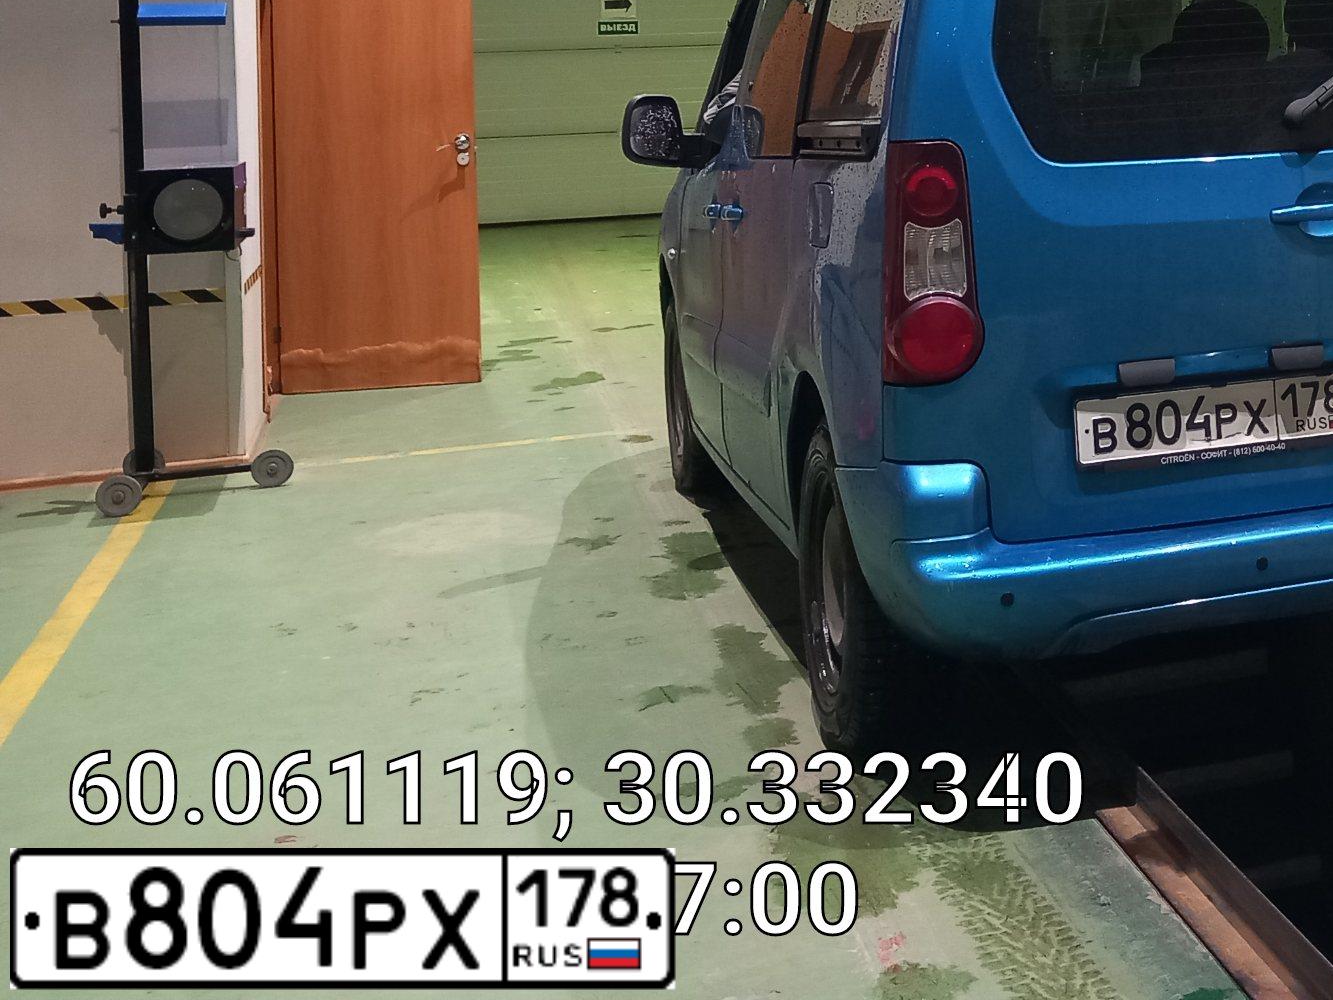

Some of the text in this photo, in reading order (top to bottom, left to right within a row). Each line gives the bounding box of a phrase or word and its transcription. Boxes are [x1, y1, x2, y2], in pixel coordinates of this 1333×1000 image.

[600, 23, 636, 32] ВЫЕЗД
[1296, 415, 1327, 432] RUS
[1233, 446, 1252, 458] (812)
[1252, 442, 1286, 454] 600-40-40
